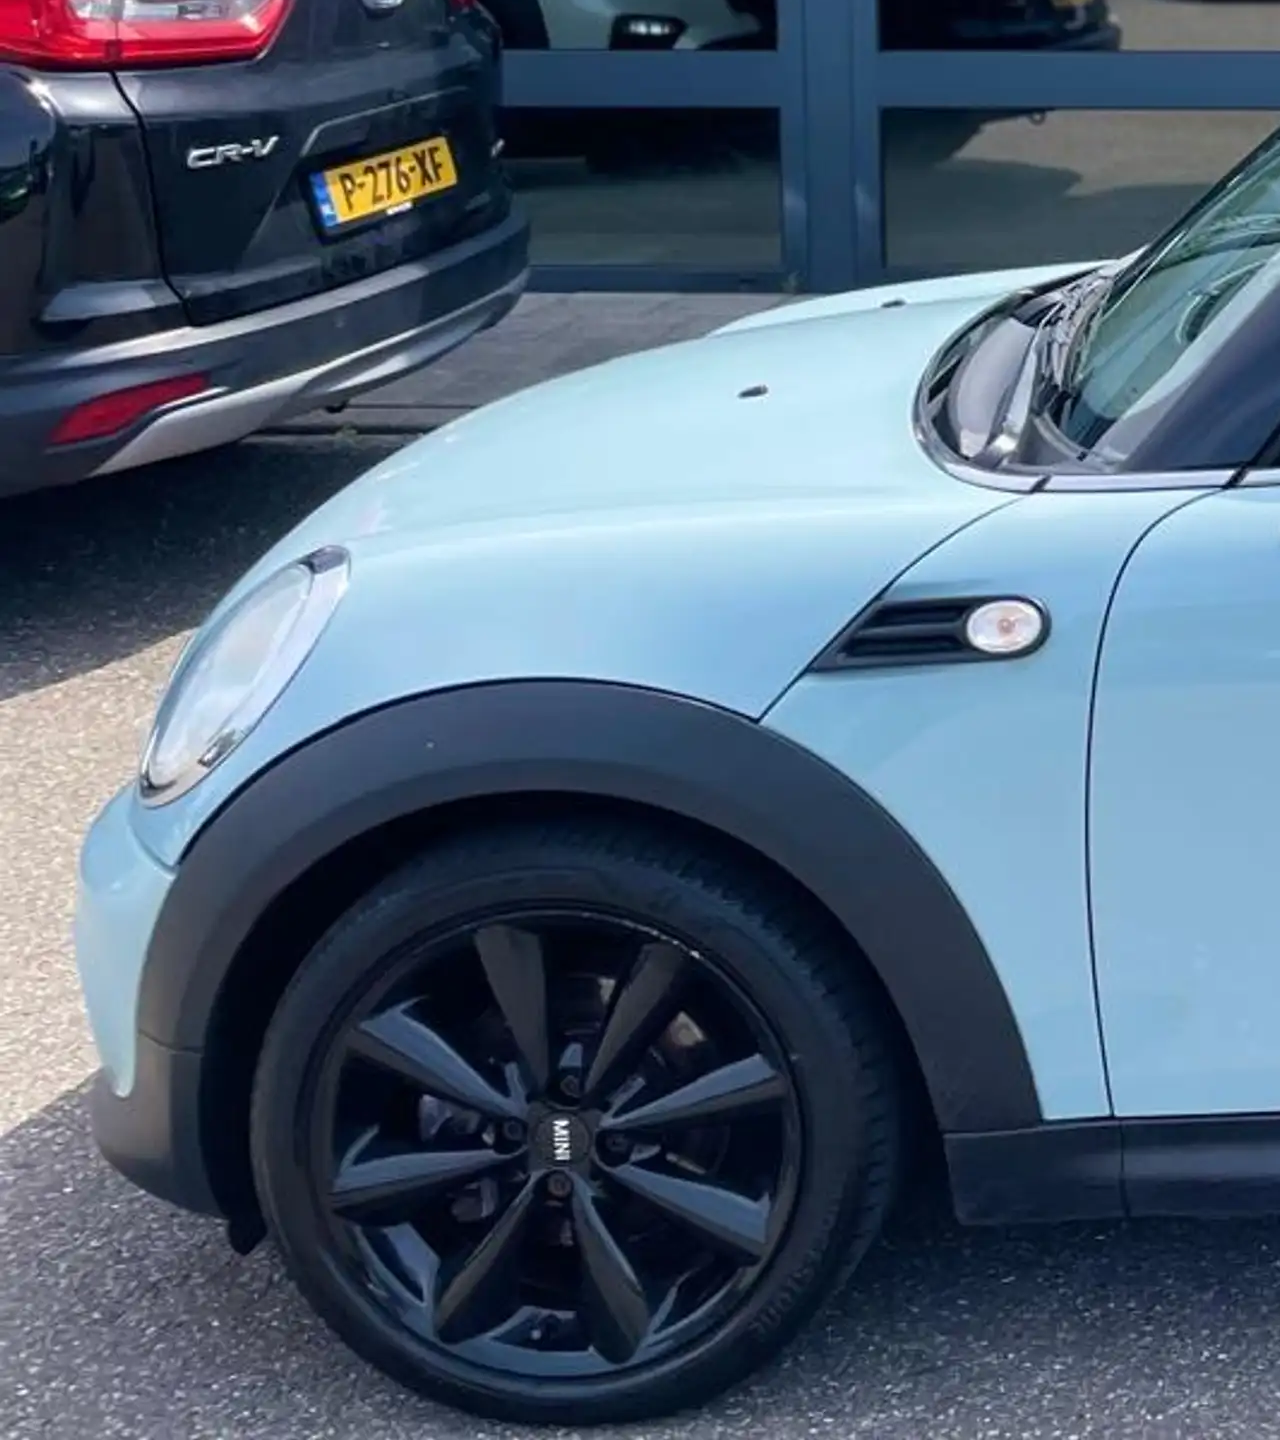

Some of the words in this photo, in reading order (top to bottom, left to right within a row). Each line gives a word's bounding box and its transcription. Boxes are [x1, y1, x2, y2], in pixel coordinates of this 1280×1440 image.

[187, 135, 279, 169] CR-V
[338, 145, 443, 213] P-276-XF
[552, 1118, 571, 1160] MINI
